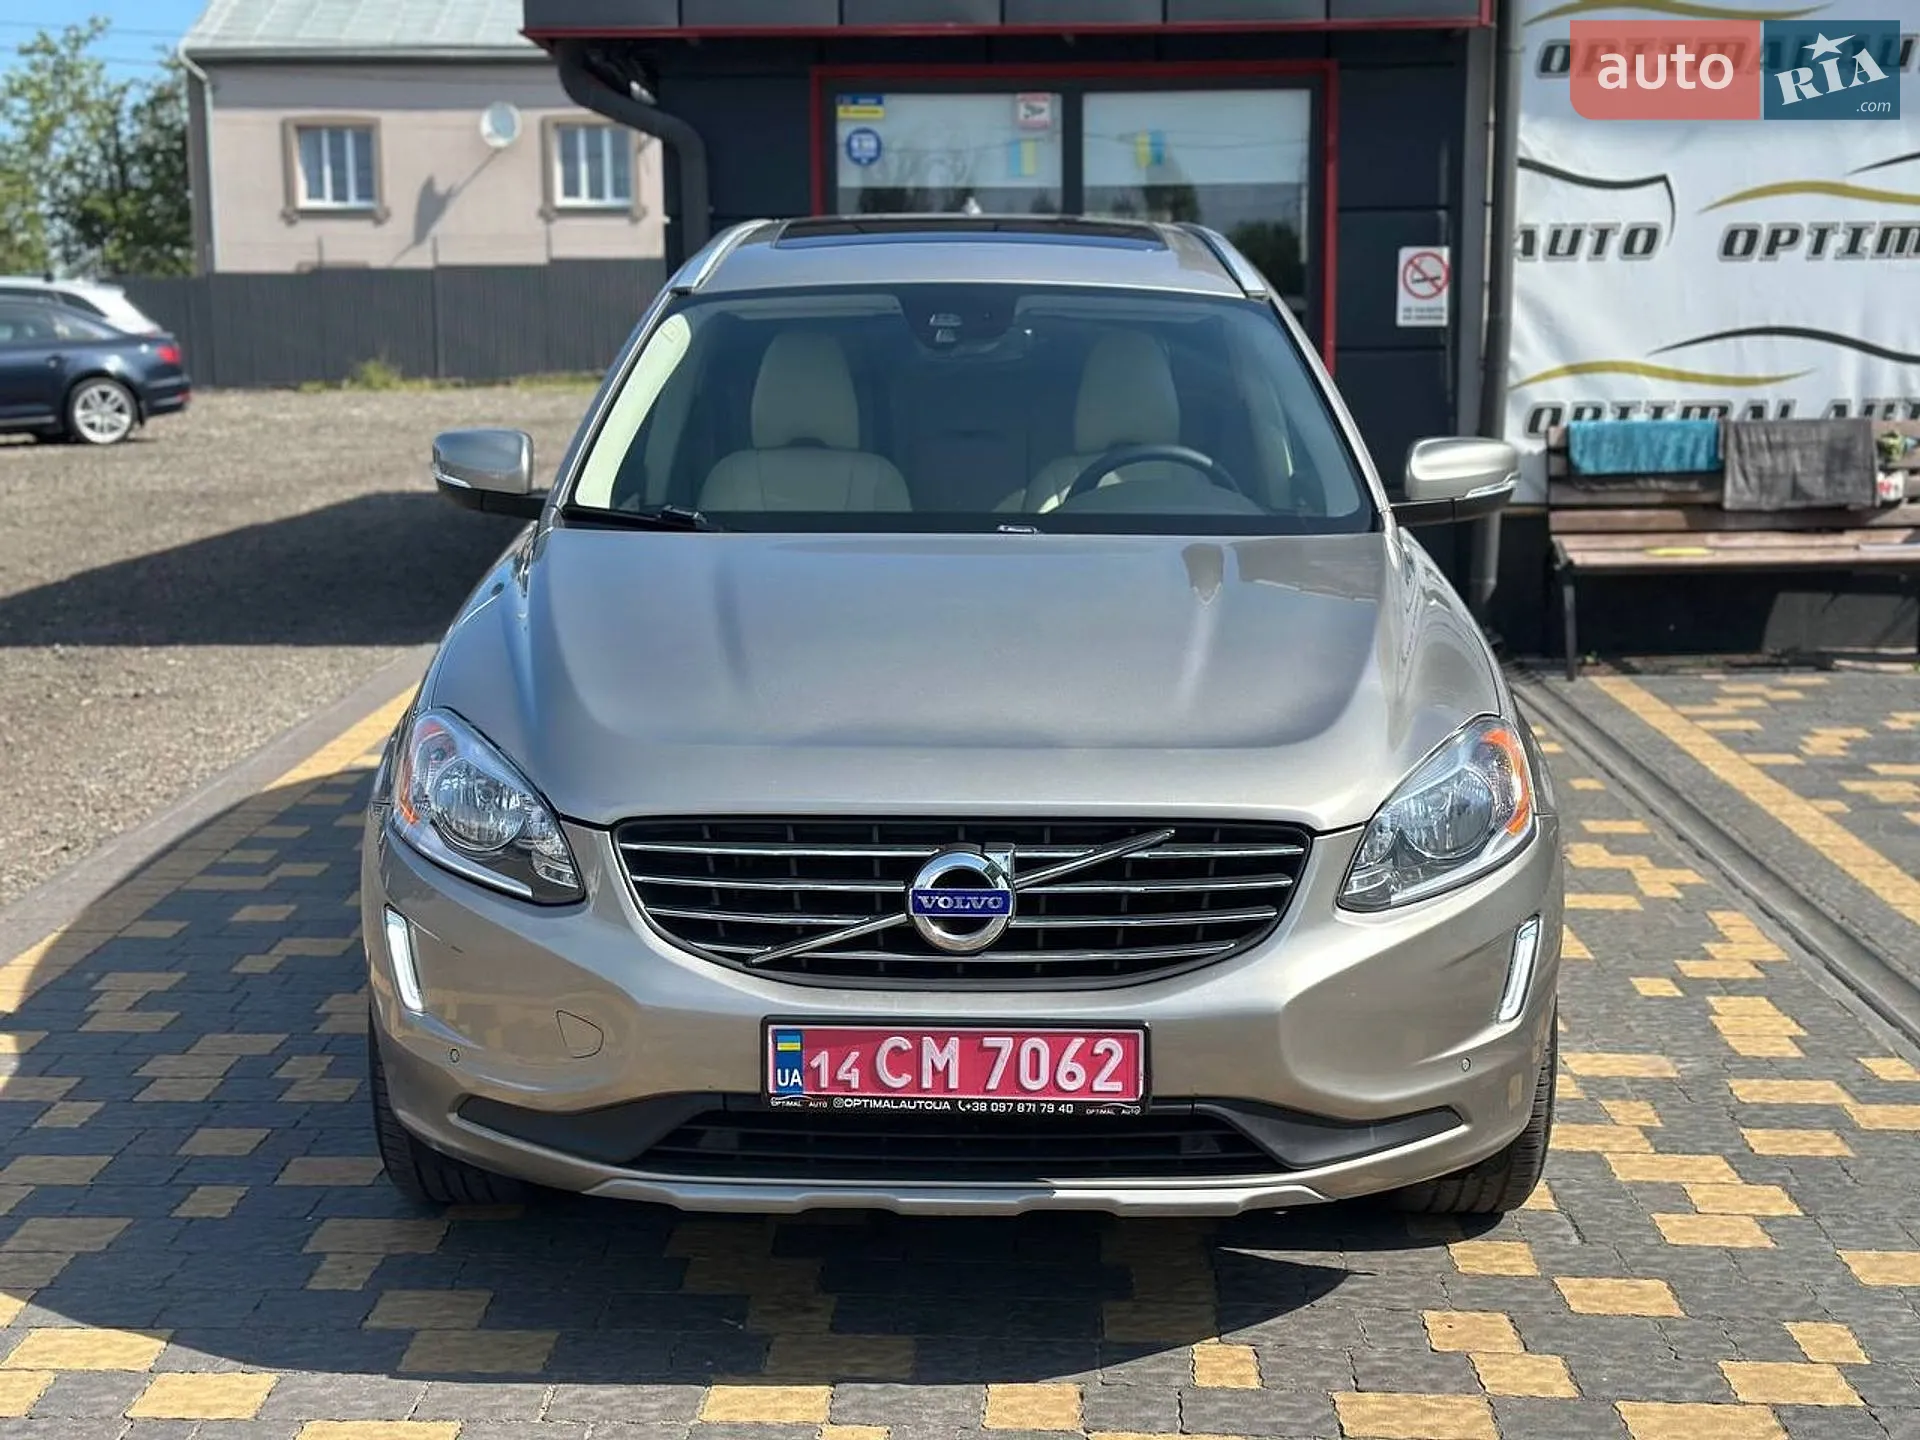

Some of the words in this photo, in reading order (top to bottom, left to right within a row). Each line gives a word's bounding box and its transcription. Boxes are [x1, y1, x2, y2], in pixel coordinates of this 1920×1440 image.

[917, 895, 1003, 909] VOLVO
[809, 1051, 860, 1089] 14
[876, 1036, 960, 1090] CM
[982, 1037, 1124, 1092] 7062
[777, 1068, 802, 1087] UA
[965, 1102, 987, 1112] +38
[1016, 1103, 1036, 1113] 871
[1040, 1104, 1054, 1113] 79
[1058, 1104, 1074, 1114] 40
